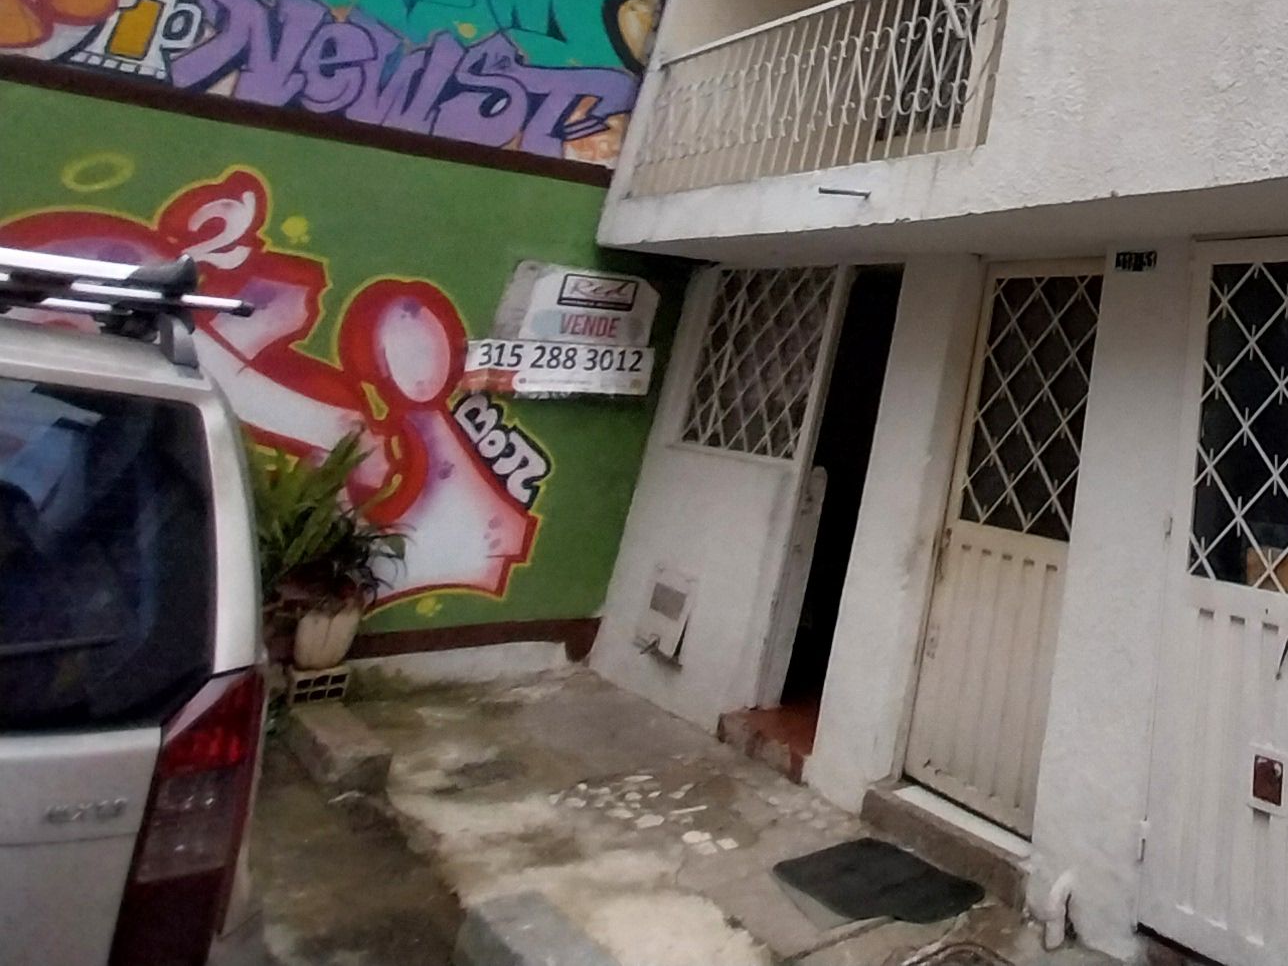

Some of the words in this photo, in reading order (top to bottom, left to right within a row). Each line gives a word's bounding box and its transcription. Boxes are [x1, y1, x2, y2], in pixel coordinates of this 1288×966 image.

[560, 313, 621, 338] VENDE
[478, 343, 524, 367] 315
[530, 345, 577, 369] 288
[583, 348, 643, 372] 3012
